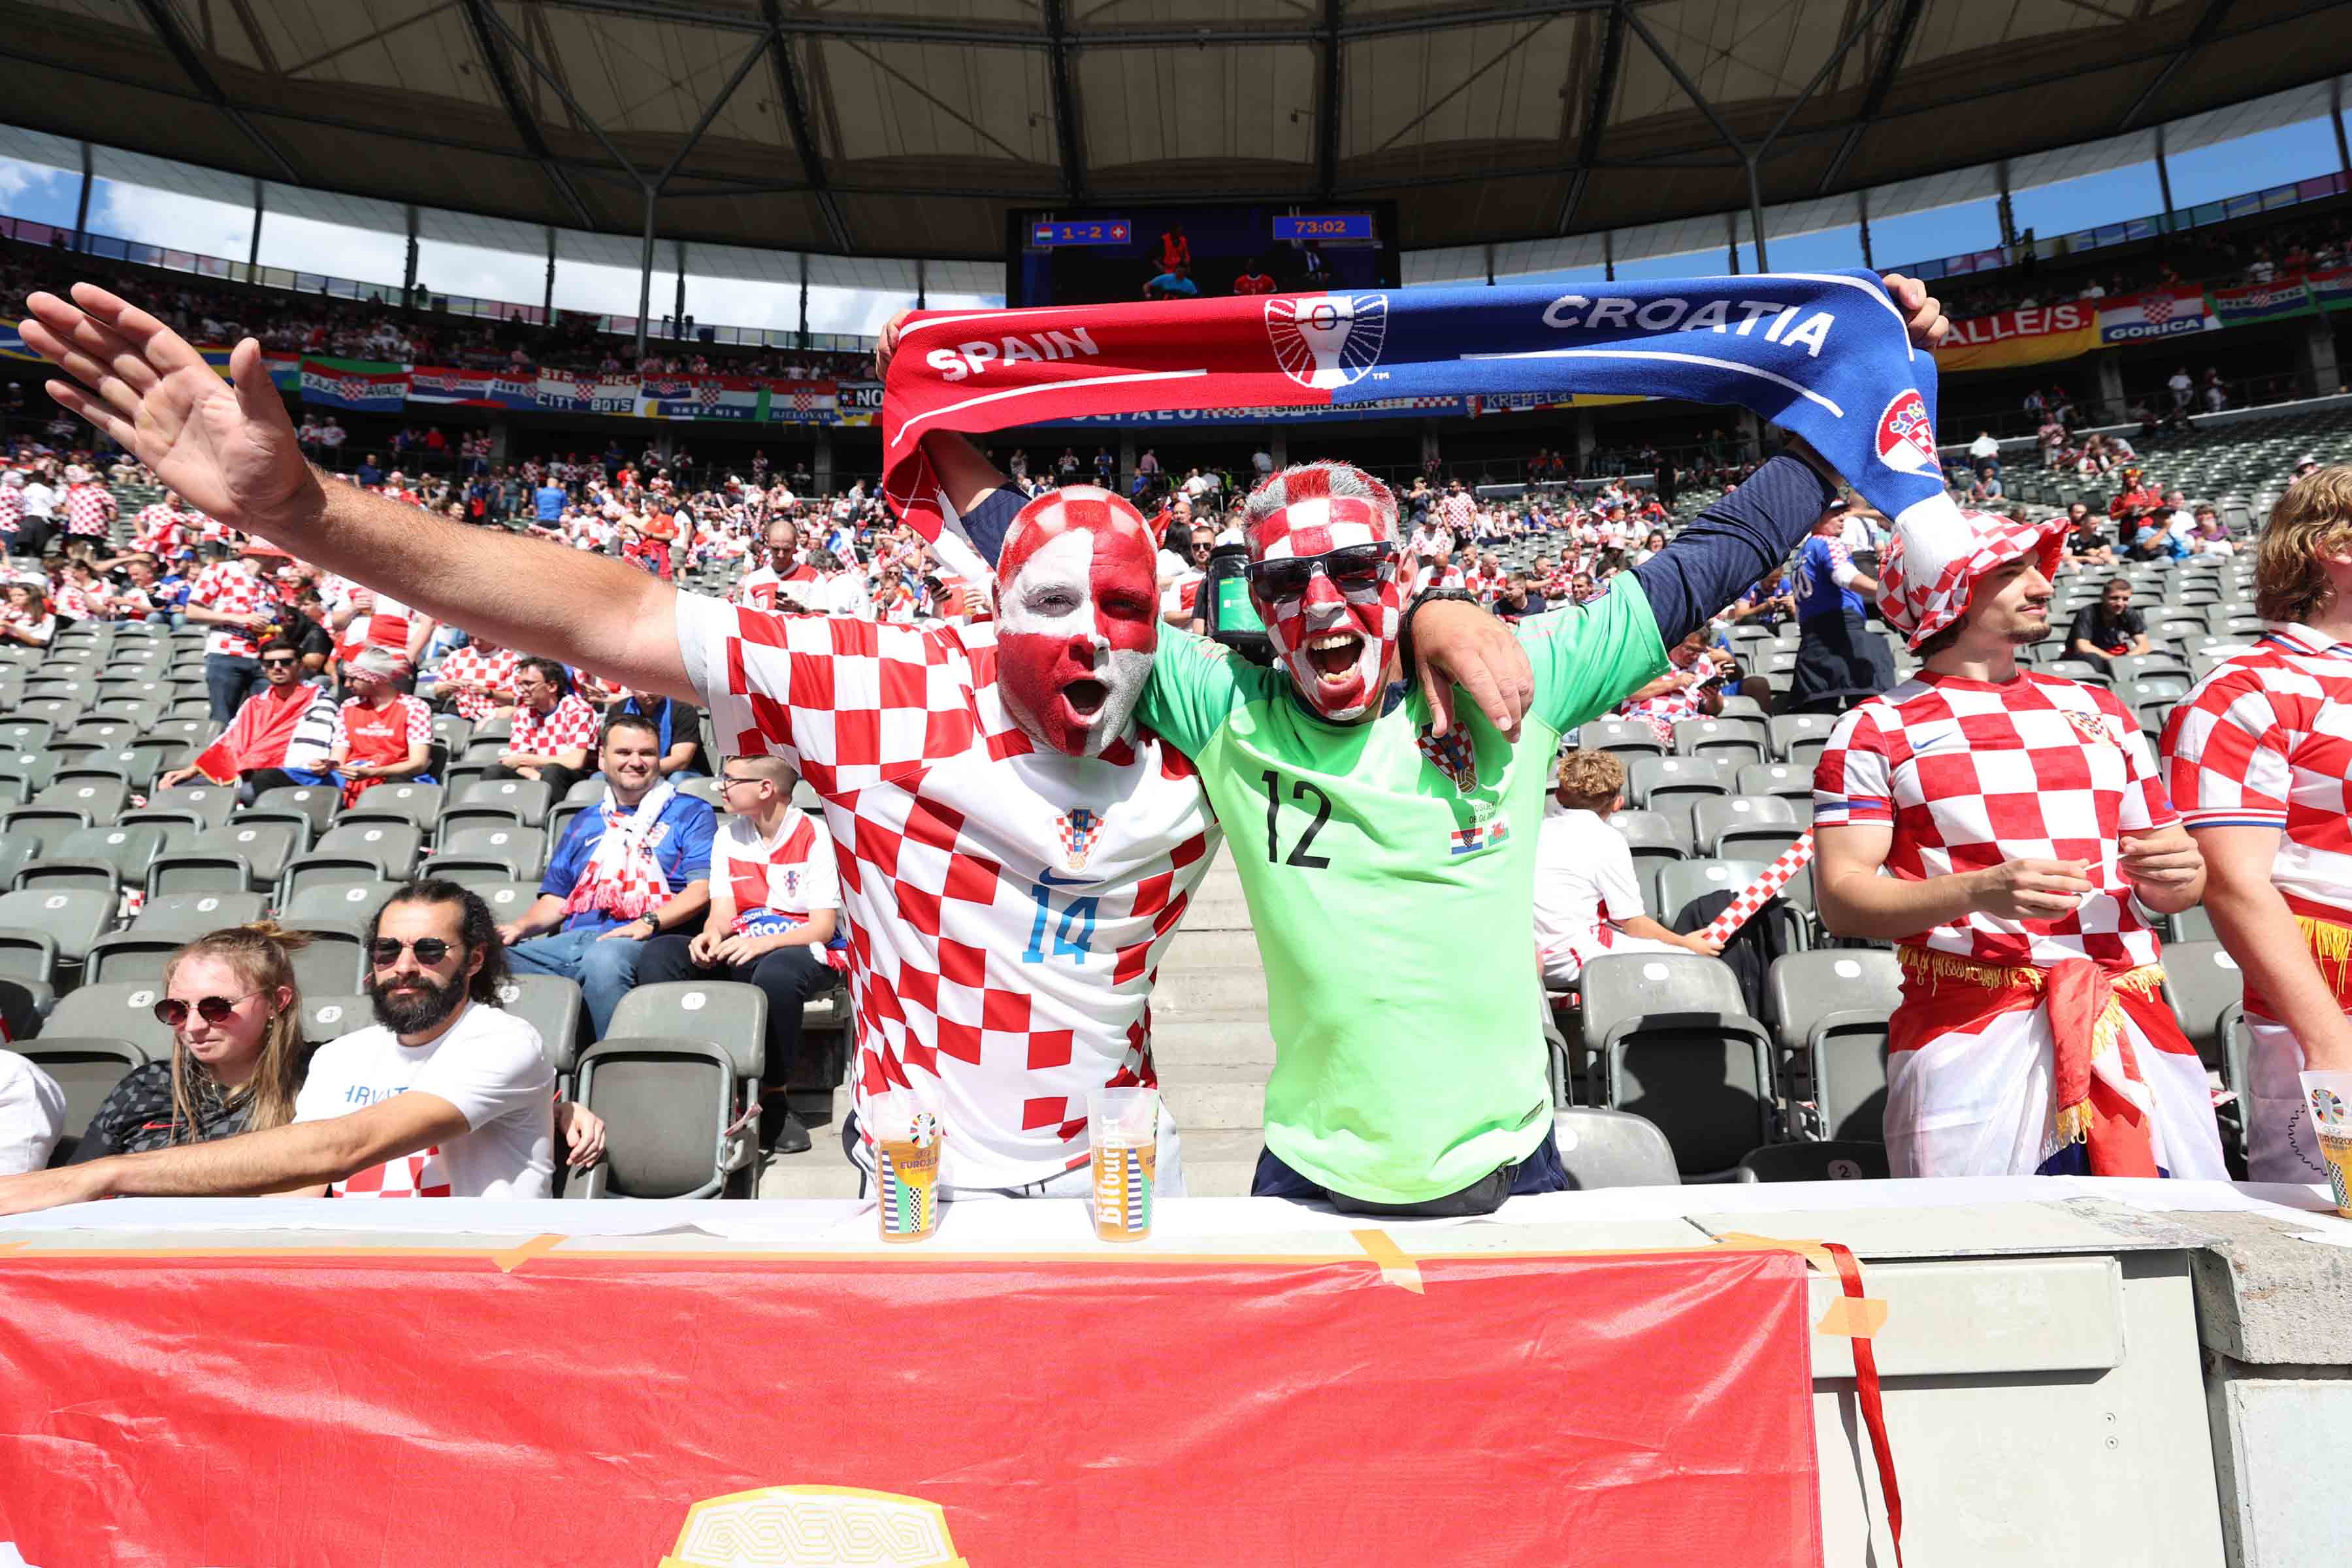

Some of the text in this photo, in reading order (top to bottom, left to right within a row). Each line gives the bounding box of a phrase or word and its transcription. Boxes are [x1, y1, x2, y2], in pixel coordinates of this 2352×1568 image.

[1296, 220, 1347, 235] 73:02
[1542, 295, 1835, 357] CROATIA
[2109, 319, 2200, 339] GORICA
[926, 327, 1099, 381] SPAIN
[536, 392, 633, 411] CITY BOYS
[1262, 770, 1331, 869] 12
[1022, 884, 1099, 964] 14
[1838, 1165, 1851, 1179] 2
